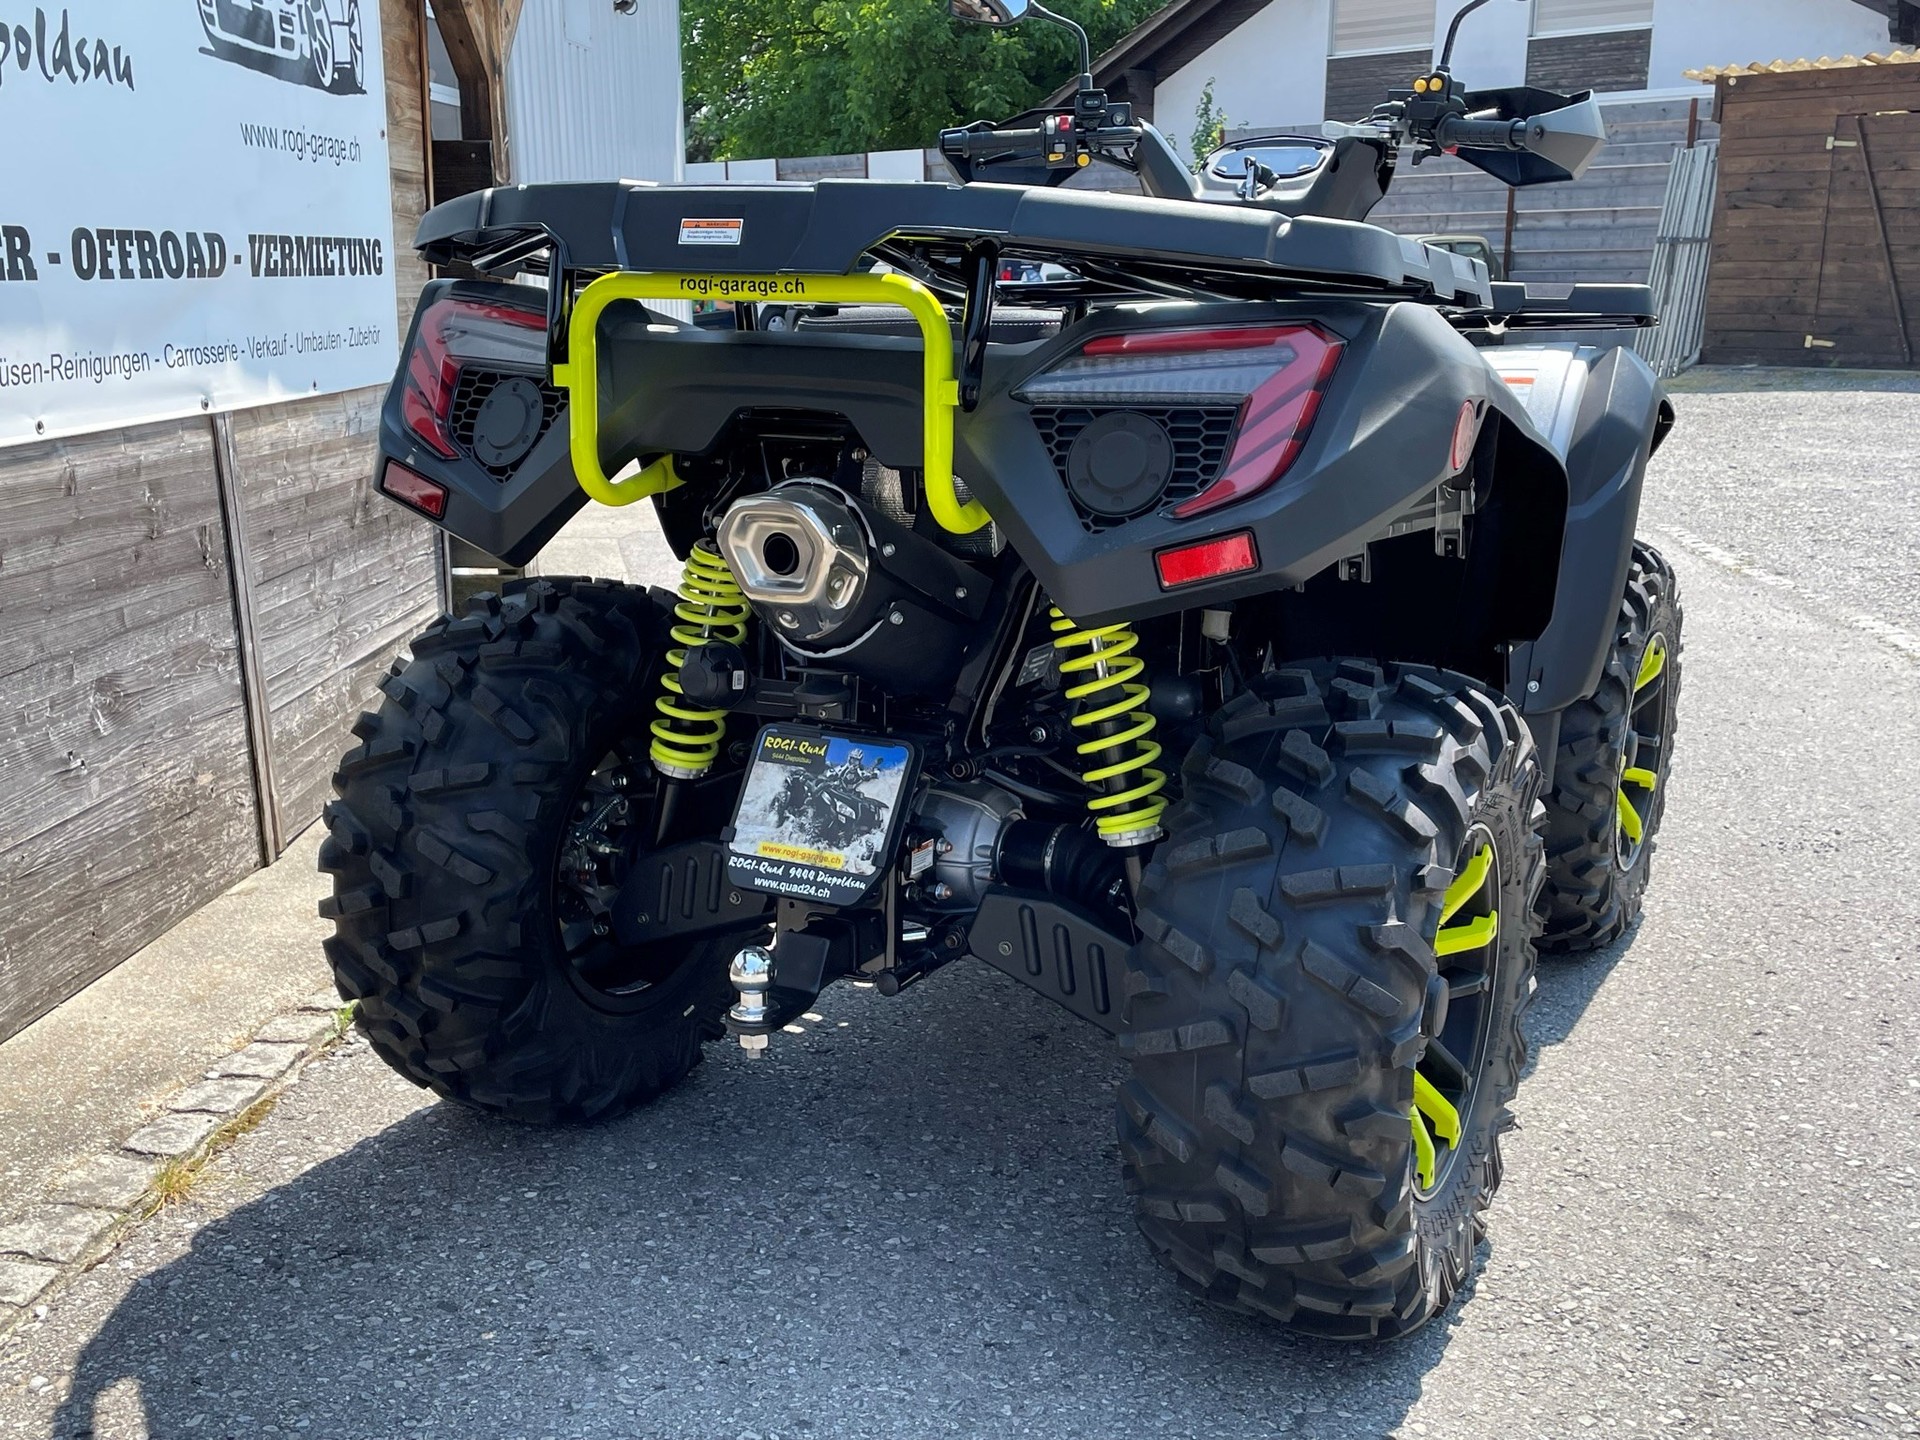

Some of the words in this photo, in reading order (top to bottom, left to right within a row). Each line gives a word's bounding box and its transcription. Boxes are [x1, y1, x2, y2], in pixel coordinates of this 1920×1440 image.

[240, 122, 361, 166] www.rogi-garage.ch
[0, 225, 38, 281] R
[71, 226, 227, 281] OFFROAD
[248, 233, 383, 278] VERMIETUNG
[680, 275, 806, 296] rogi-garage.ch
[163, 343, 238, 369] Carrosserie
[246, 333, 288, 360] Verkauf
[296, 331, 341, 354] Umbauten
[348, 325, 381, 347] Zubehör
[764, 736, 828, 757] ROGI-Quad
[762, 845, 841, 865] www.rogi-garage.ch
[728, 856, 785, 876] ROGI-Quad
[789, 866, 815, 881] 9444
[816, 870, 867, 890] Diepoldsau
[754, 877, 831, 898] www.quad24.ch
